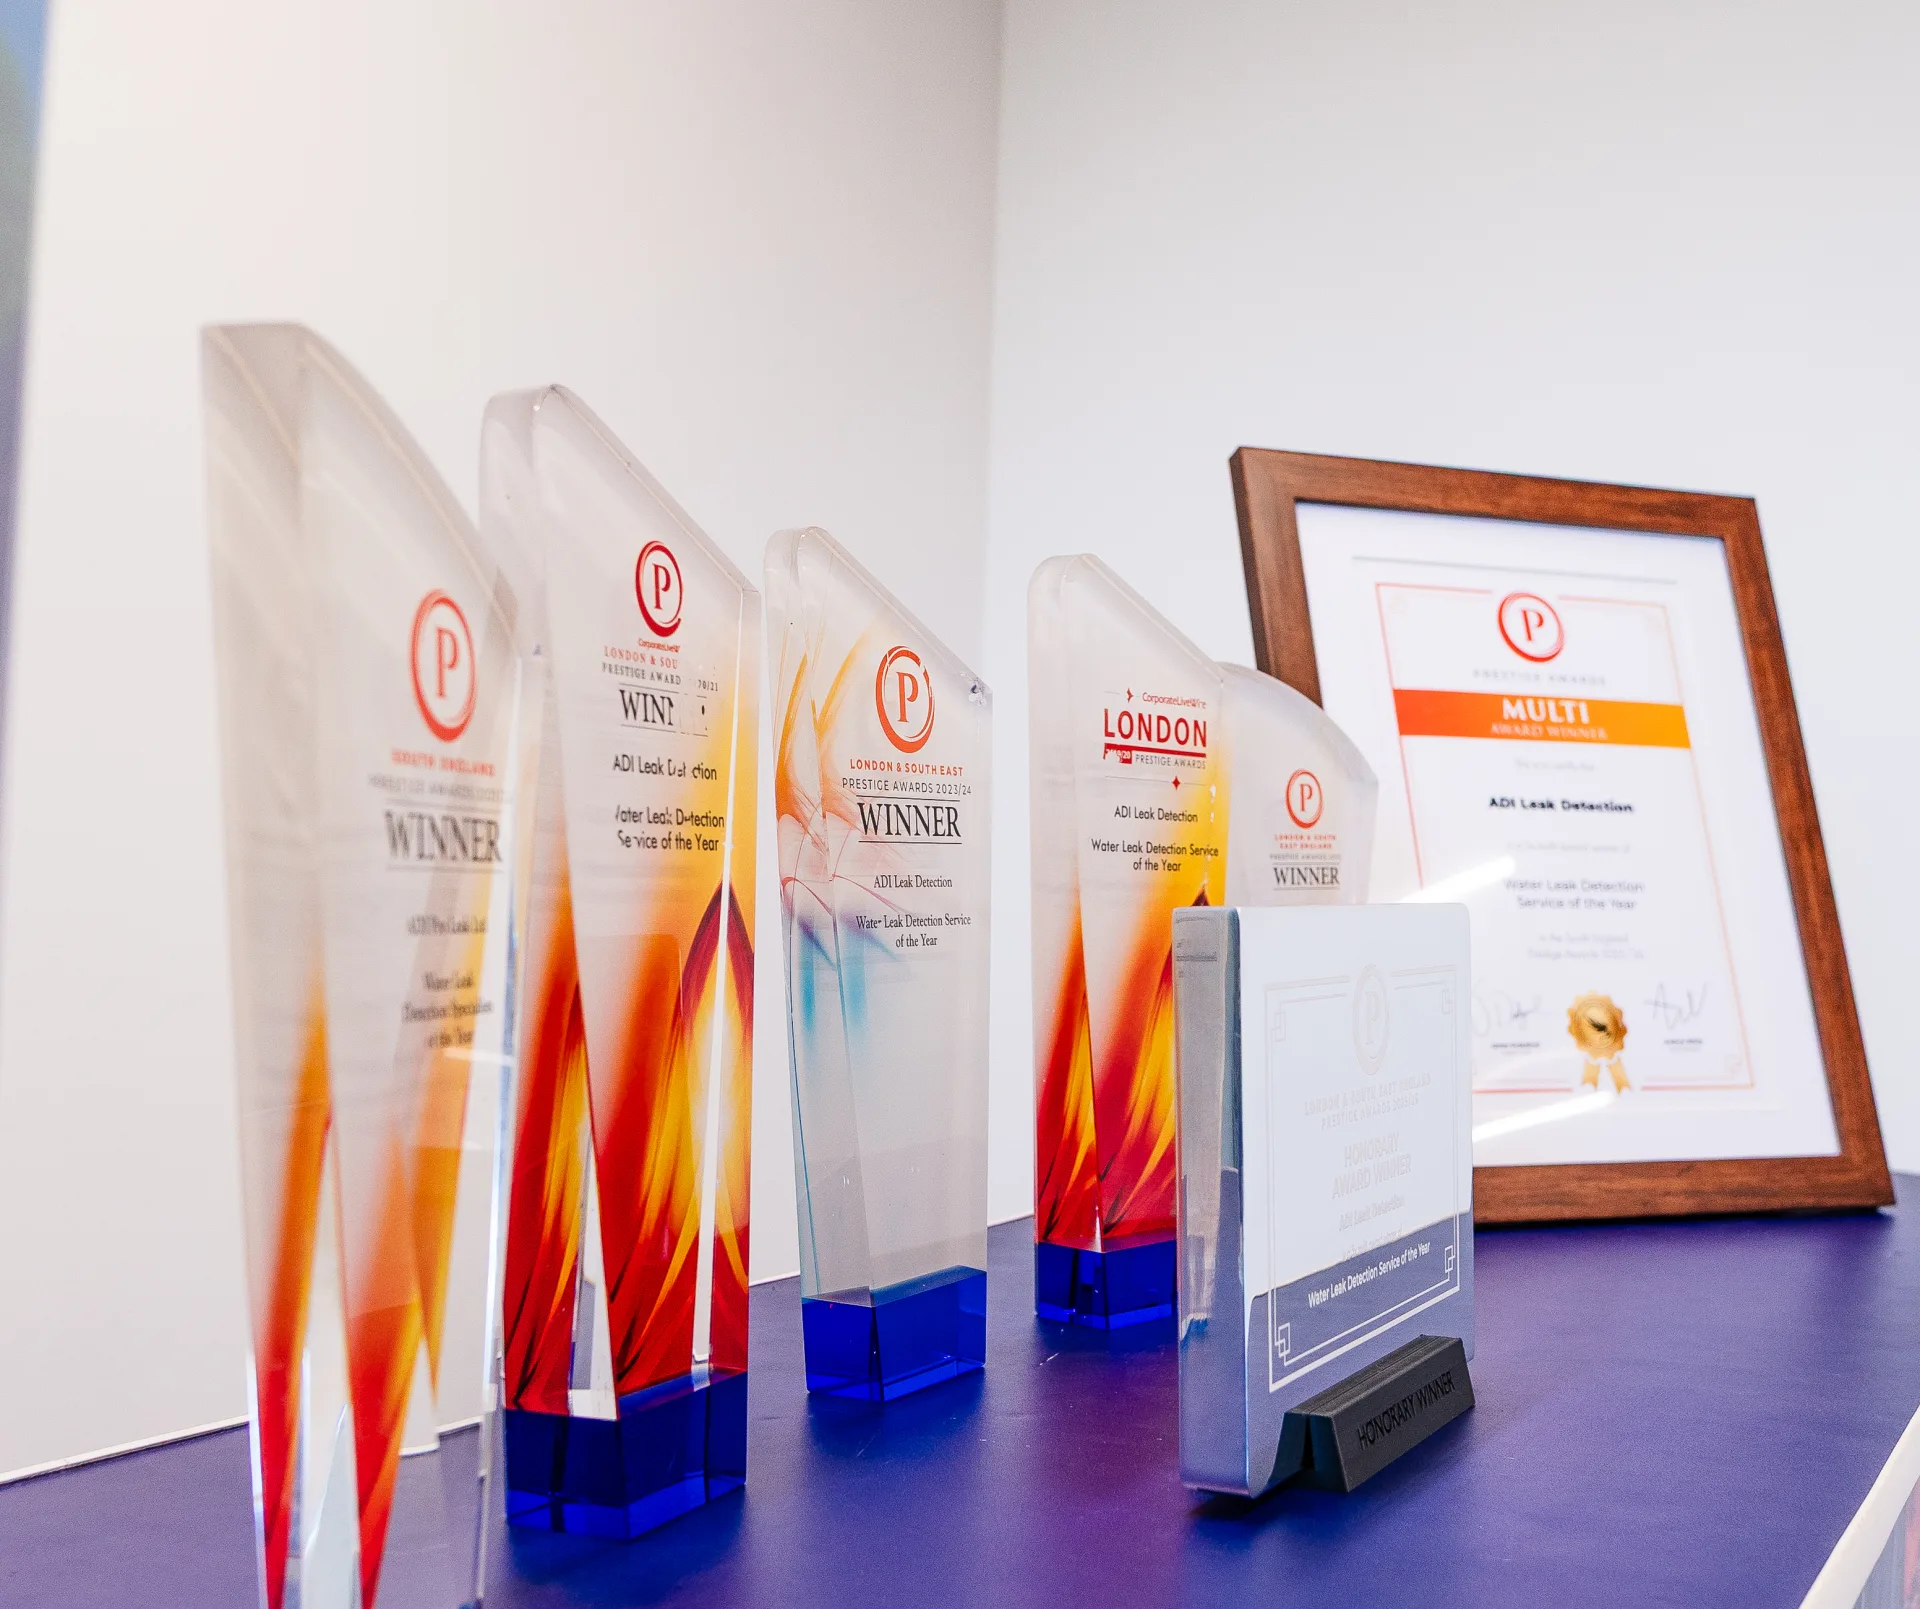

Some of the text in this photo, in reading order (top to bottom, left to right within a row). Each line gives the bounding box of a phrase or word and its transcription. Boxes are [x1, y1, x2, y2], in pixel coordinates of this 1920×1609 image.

[652, 563, 671, 611] P
[1521, 608, 1544, 642] P
[436, 627, 460, 698] P
[604, 645, 646, 663] LONDON
[659, 655, 678, 669] SOU
[602, 662, 646, 680] PRESTIGE
[650, 670, 681, 686] AWARD
[896, 671, 919, 723] P
[1502, 697, 1591, 725] MULTI
[1104, 708, 1207, 748] LONDON
[1491, 722, 1608, 740] AWARD WINNER
[613, 754, 635, 772] ADI
[638, 756, 665, 775] Leak
[849, 758, 963, 777] LONDON & SOUTH EAST
[1135, 754, 1171, 766] PRESTIGE
[1174, 758, 1206, 769] AWARDS
[842, 777, 972, 796] PRESTIGE AWARDS 2023/24
[1299, 783, 1313, 812] P
[1489, 797, 1634, 812] ADI Leak Detection
[857, 802, 962, 838] WINNER
[1114, 805, 1198, 822] ADI Leak Detection
[384, 810, 502, 862] WINNER
[661, 831, 672, 850] of
[675, 831, 692, 850] the
[695, 833, 720, 851] Year
[1091, 838, 1219, 857] Water Leak Detection Service
[1133, 857, 1181, 872] of the Year
[874, 874, 953, 888] ADI Leak Detection
[1273, 866, 1340, 886] WINNER
[856, 912, 971, 929] Water Leak Detection Service
[895, 933, 938, 947] of the Year
[1308, 1241, 1431, 1309] Water Leak Detection Service of the Year
[1357, 1371, 1456, 1452] HONORARY WINNER
